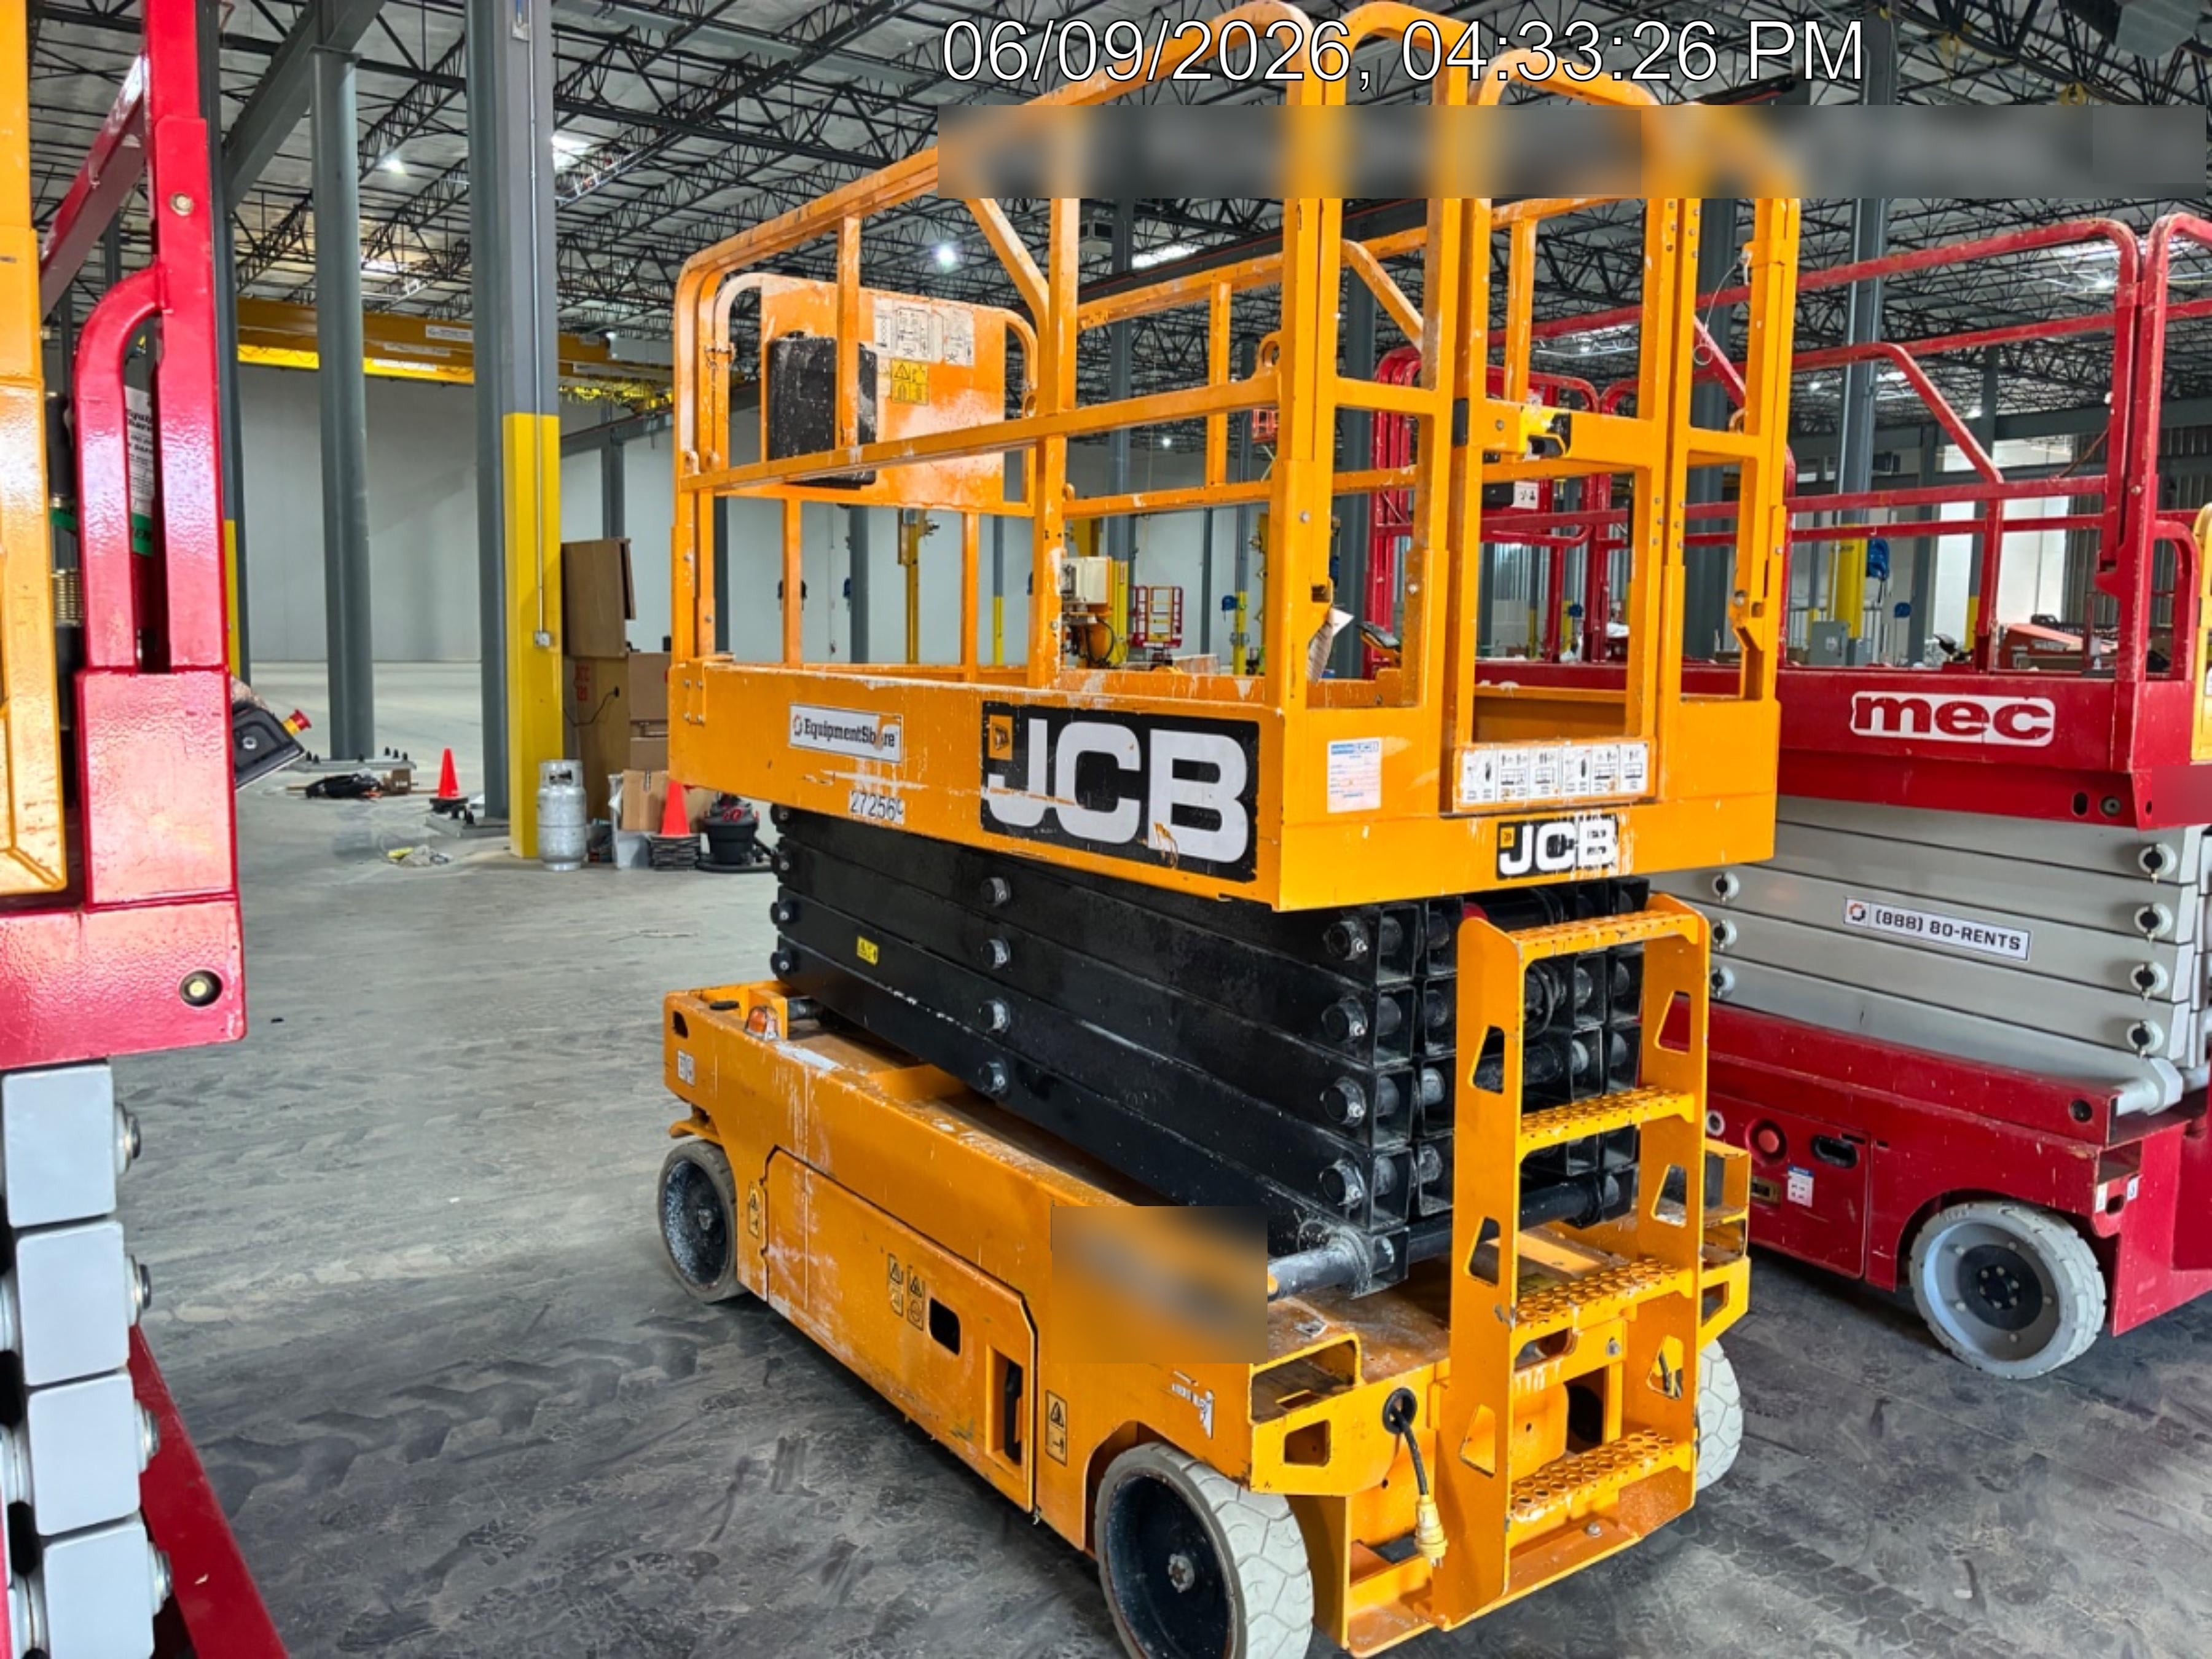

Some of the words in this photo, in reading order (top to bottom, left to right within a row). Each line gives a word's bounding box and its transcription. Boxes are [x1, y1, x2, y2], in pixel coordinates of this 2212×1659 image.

[804, 718, 895, 747] EquipmentShre
[1854, 696, 2051, 740] mec
[987, 718, 1249, 863] JCB
[1499, 819, 1616, 875] JCB
[1876, 909, 1923, 931] (888)
[1929, 920, 2022, 950] 80-RENTS
